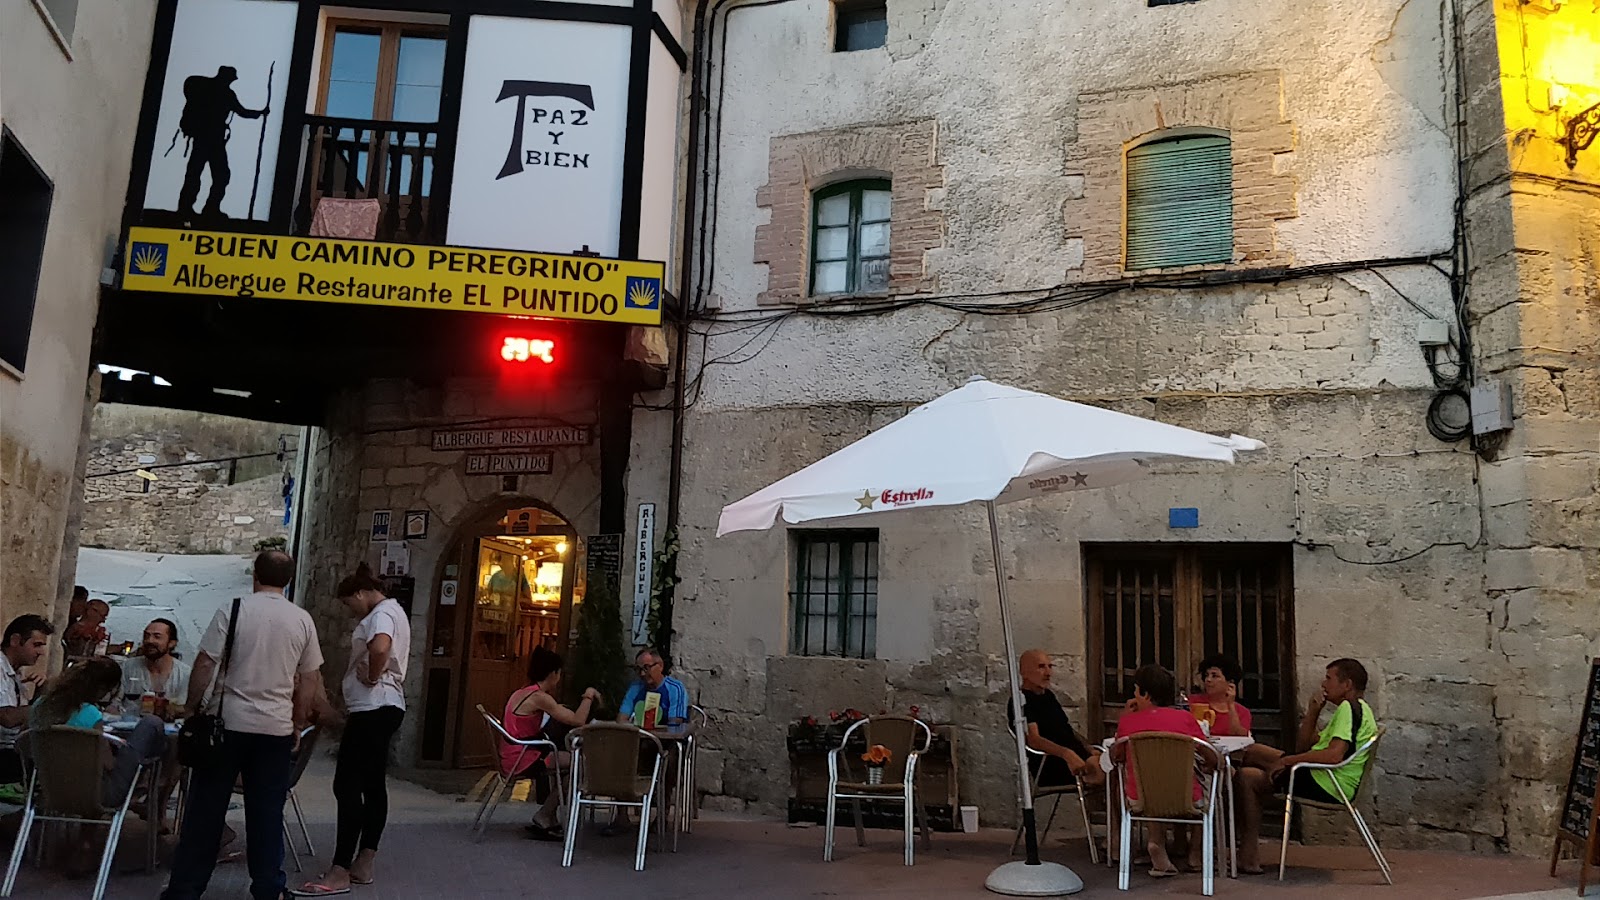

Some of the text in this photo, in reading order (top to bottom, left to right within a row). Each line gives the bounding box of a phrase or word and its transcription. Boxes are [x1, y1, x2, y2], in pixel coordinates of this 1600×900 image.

[532, 108, 589, 126] PAZ
[548, 131, 564, 145] Y
[526, 150, 590, 168] BIEN
[179, 233, 619, 282] "BUEN CAMINO PEREGRINO"
[173, 264, 618, 315] Albergue Restaurante EL PUNTIDO
[436, 428, 584, 448] ALBERGUE RESTAURANTE
[470, 455, 546, 470] EL PUNTIDO
[881, 487, 934, 504] Estrella
[638, 508, 649, 594] ALBERGUE
